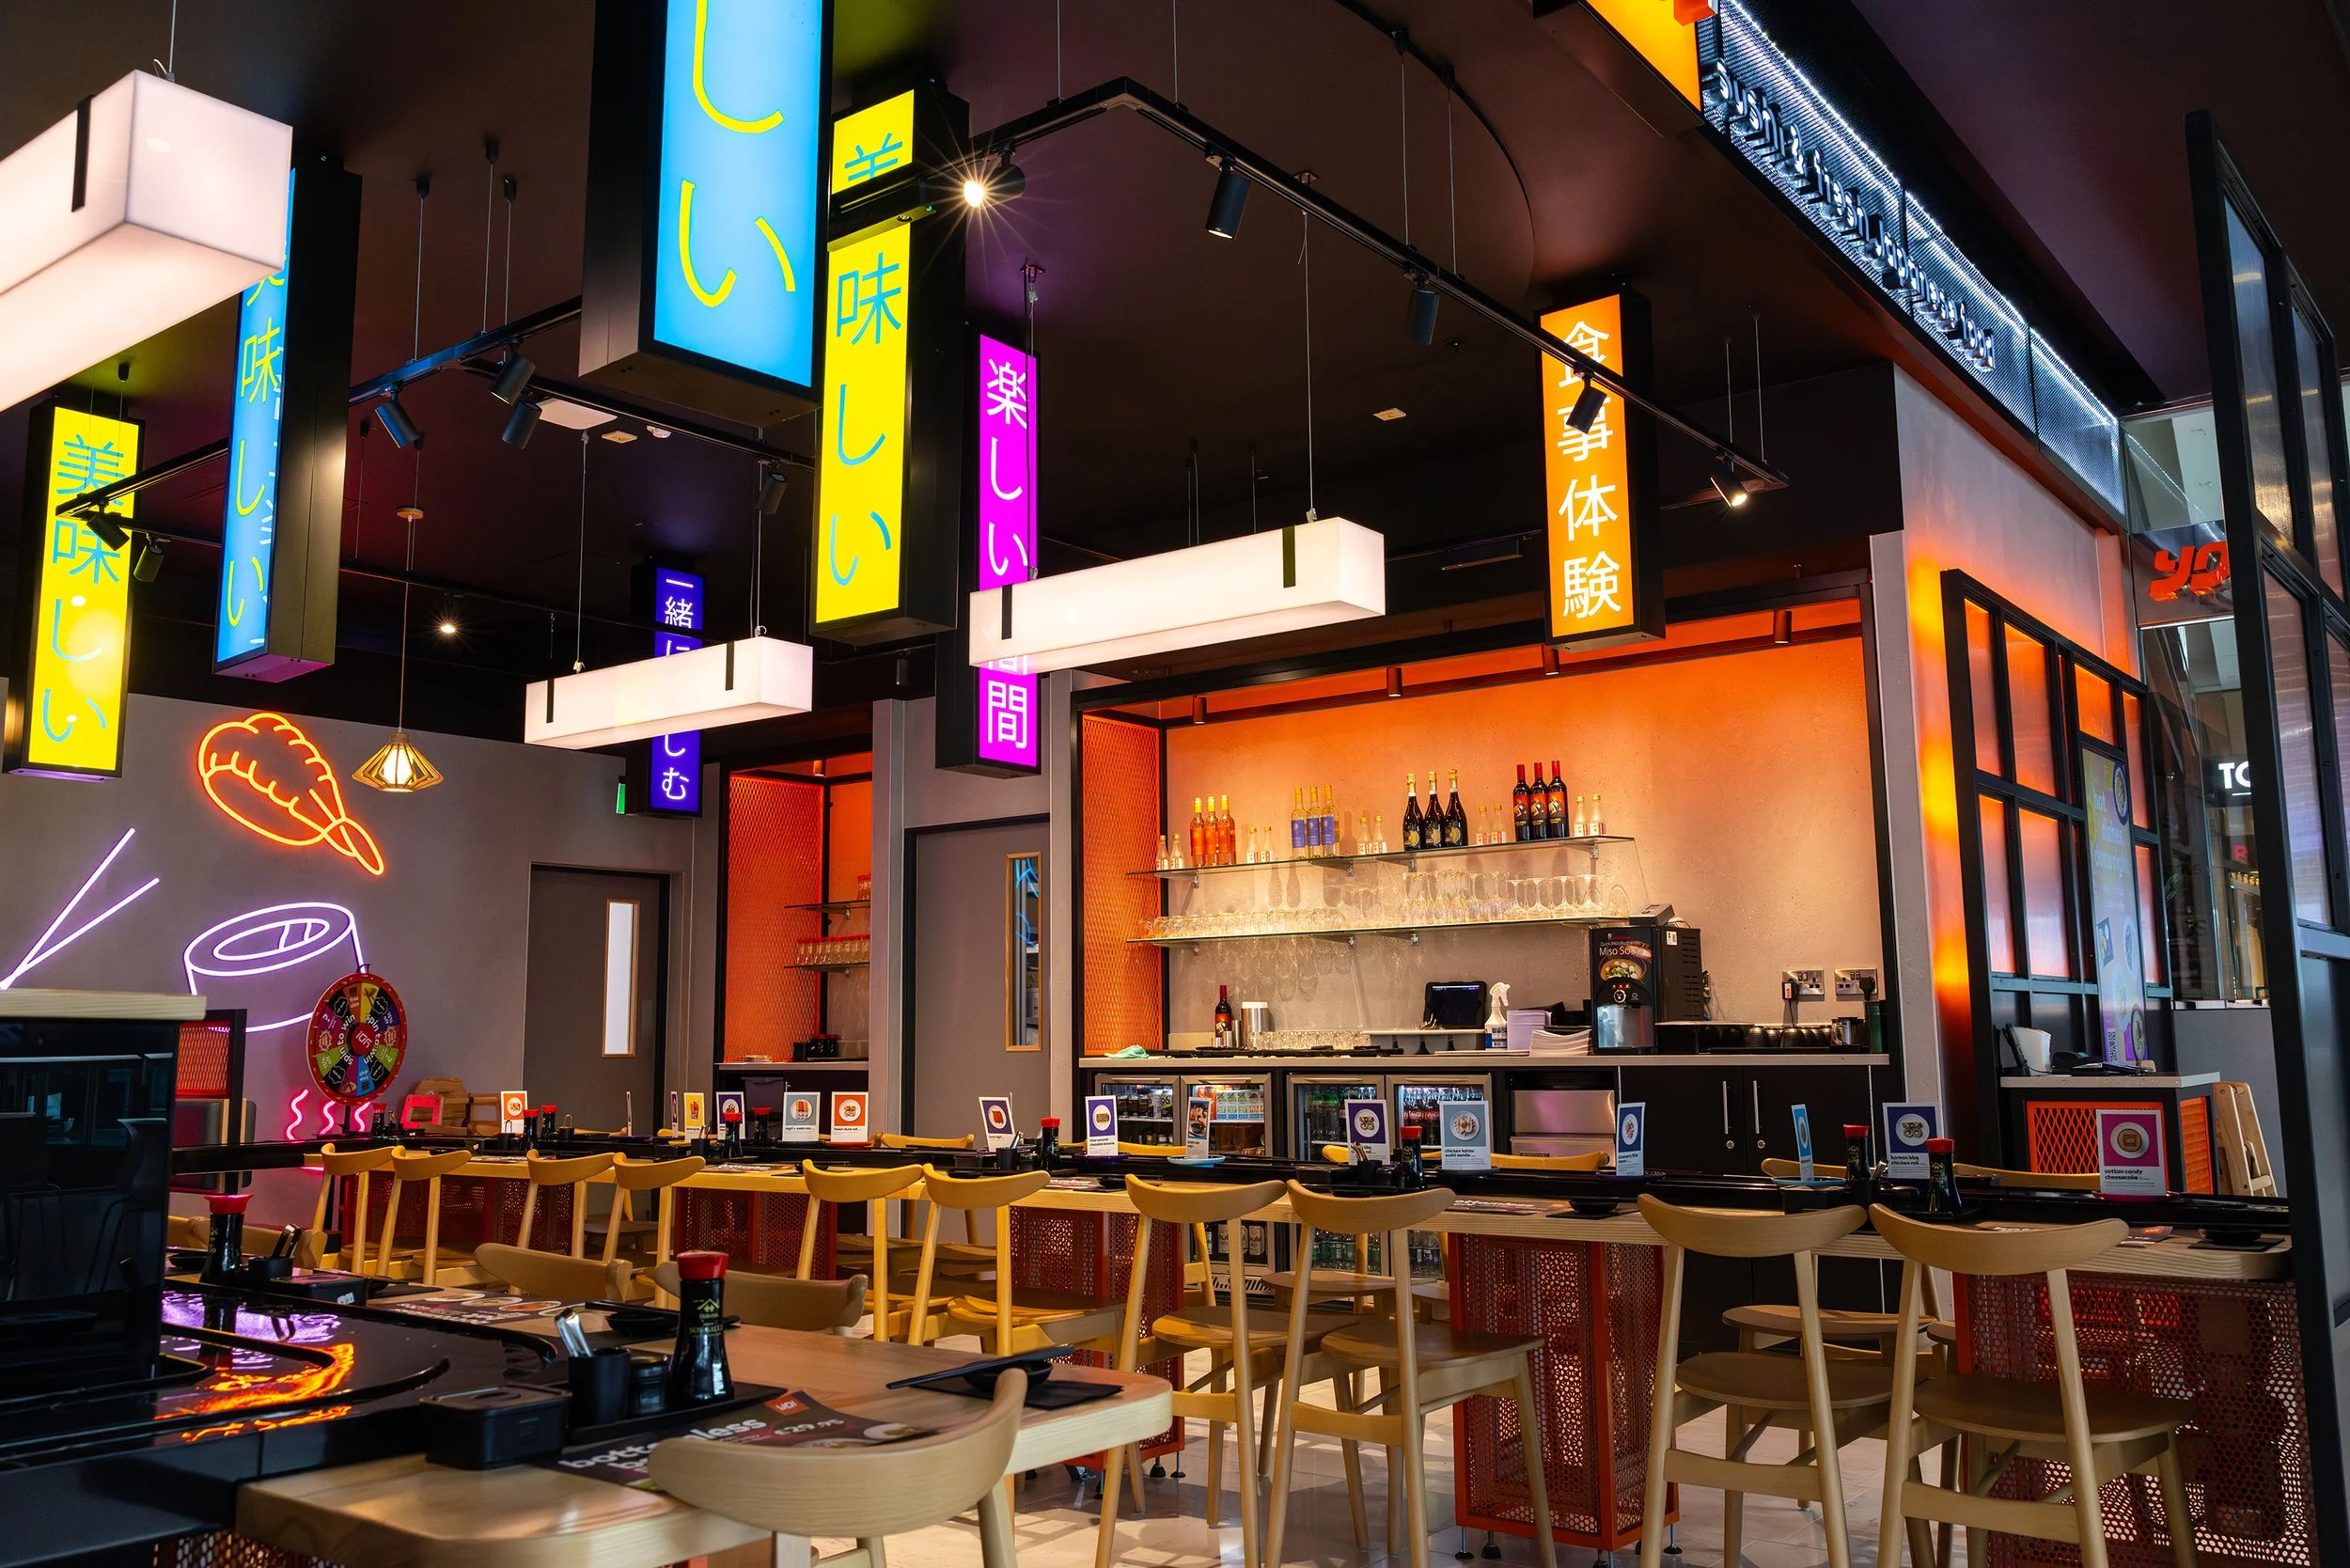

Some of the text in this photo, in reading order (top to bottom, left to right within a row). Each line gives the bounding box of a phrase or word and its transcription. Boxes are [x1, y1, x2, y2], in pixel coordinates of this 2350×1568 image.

[1790, 122, 1807, 177] &
[1814, 146, 1870, 242] fresh
[1960, 303, 1995, 372] food
[228, 242, 286, 628] 味しい
[986, 357, 1028, 750] 楽しい間
[43, 433, 125, 743] 美味しい
[1599, 946, 1643, 957] Miso Soup
[337, 1032, 344, 1045] to
[341, 1013, 356, 1030] win
[363, 1013, 382, 1064] spin to win
[339, 1047, 353, 1065] spin
[558, 1418, 768, 1469] bottless
